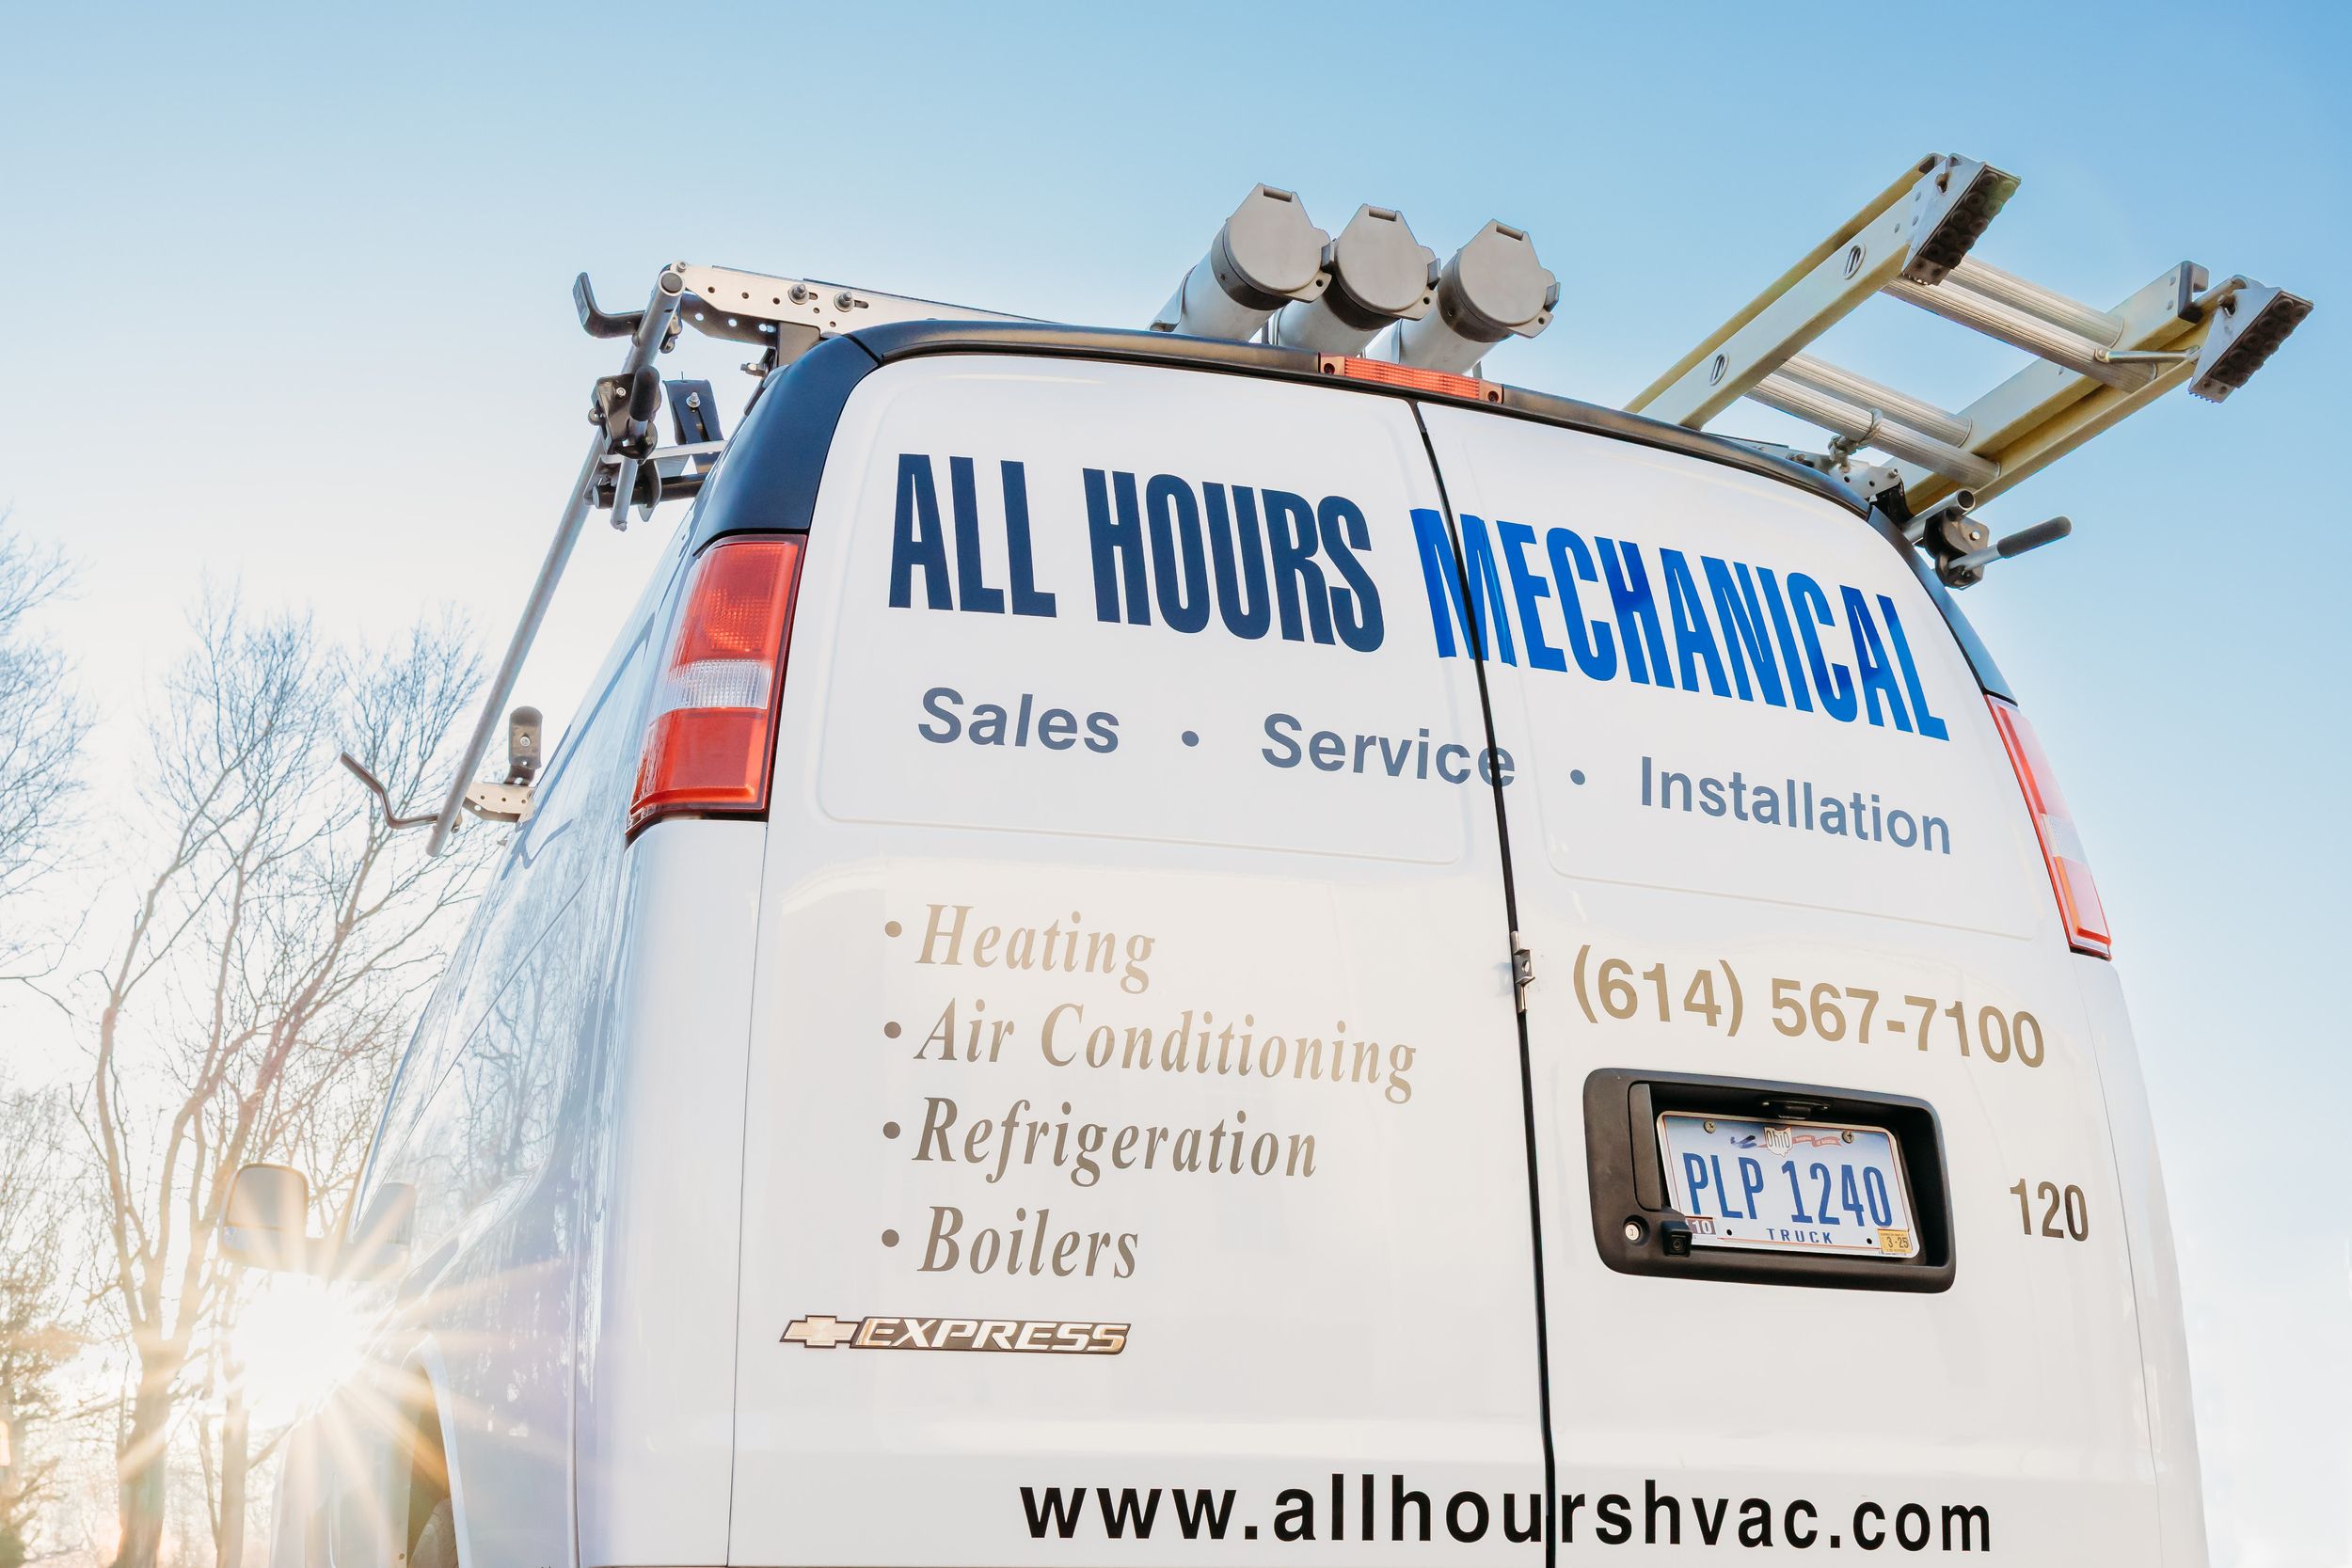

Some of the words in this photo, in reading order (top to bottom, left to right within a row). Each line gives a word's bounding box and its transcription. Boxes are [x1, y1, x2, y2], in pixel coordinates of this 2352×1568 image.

[888, 452, 1057, 619] ALL
[1082, 467, 1385, 653] HOURS
[1410, 508, 1950, 742] MECHANICAL
[917, 687, 1120, 754] Sales
[1262, 712, 1516, 788] Service
[1641, 755, 1951, 855] Installation
[914, 903, 1156, 995] Heating
[1573, 943, 1743, 1037] (614)
[1772, 977, 2045, 1069] 567-7100
[913, 997, 1015, 1063] Air
[1041, 1003, 1417, 1105] Conditioning
[911, 1096, 1317, 1188] Refrigeration
[1682, 1152, 1765, 1221] PLP
[1781, 1160, 1893, 1228] 1240
[2010, 1178, 2090, 1243] 120
[916, 1206, 1138, 1279] Boilers
[1766, 1227, 1834, 1244] TRUCK
[857, 1318, 1128, 1353] EXPRESS
[1019, 1474, 1992, 1553] www.allhourshvac.com
